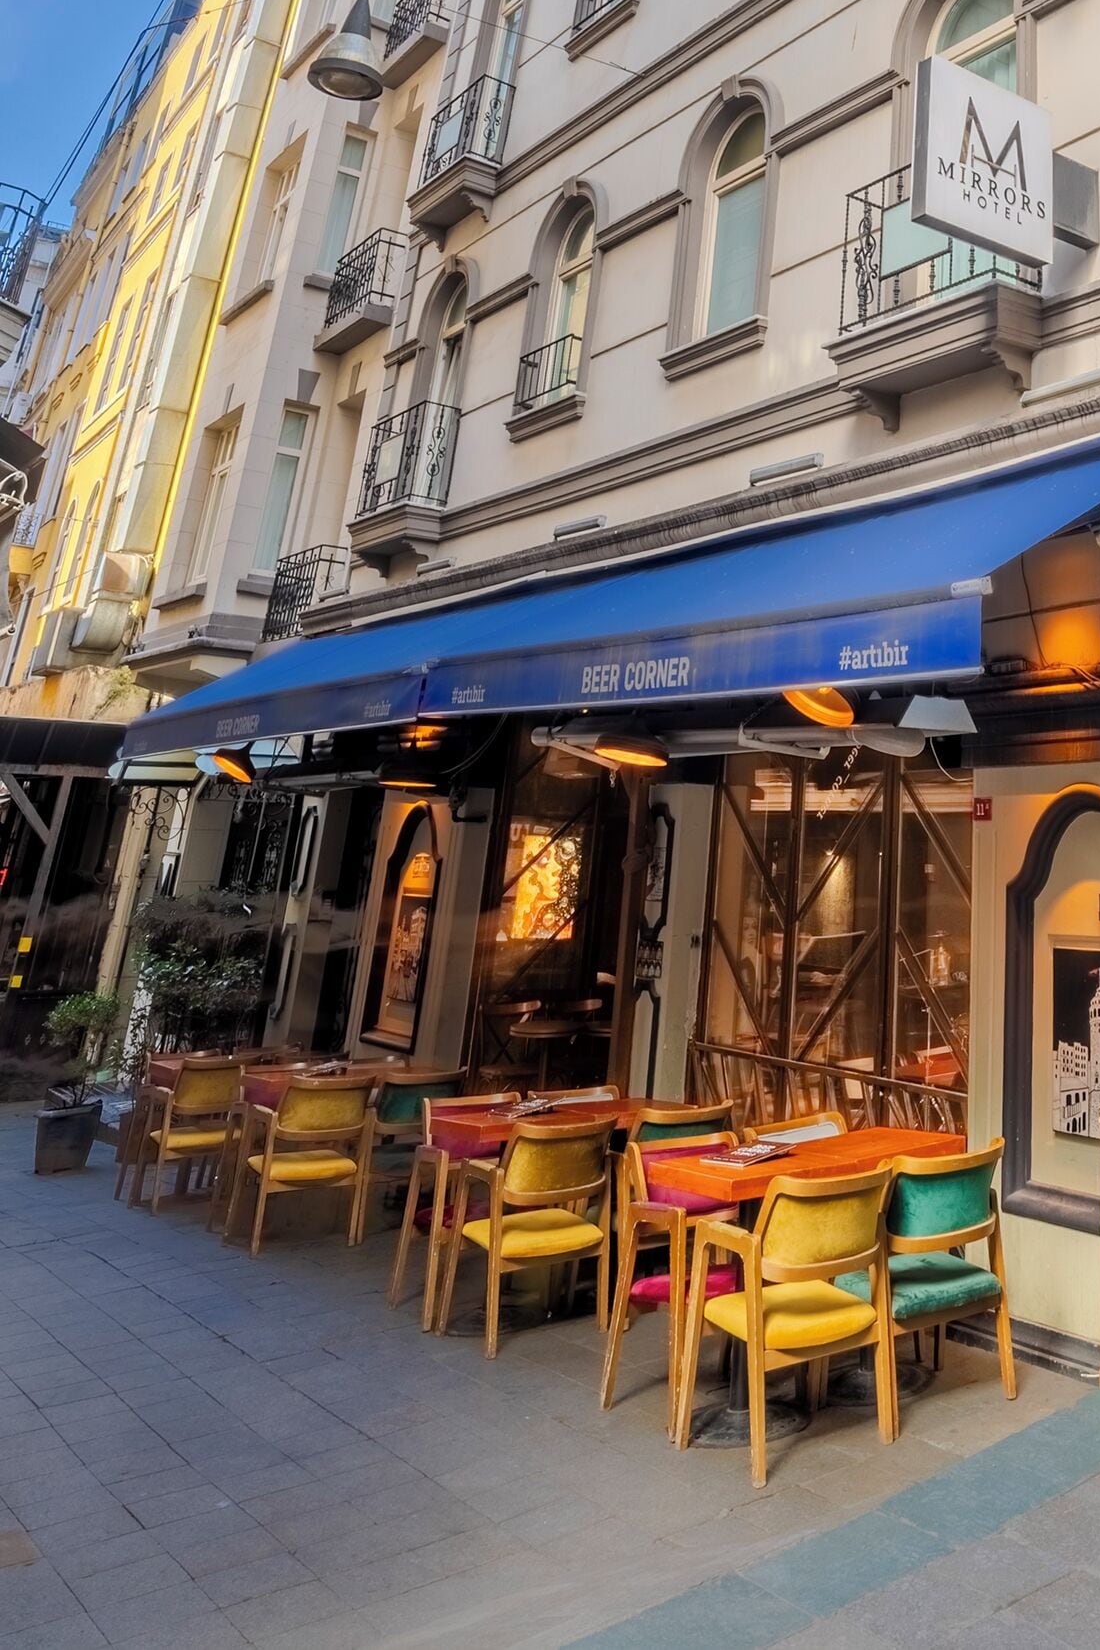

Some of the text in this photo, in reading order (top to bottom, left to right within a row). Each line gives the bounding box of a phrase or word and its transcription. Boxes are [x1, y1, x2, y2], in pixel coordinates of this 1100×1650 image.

[938, 156, 1046, 219] MIRRORS
[962, 189, 1022, 225] HOTEL
[581, 656, 690, 694] BEER CORNER
